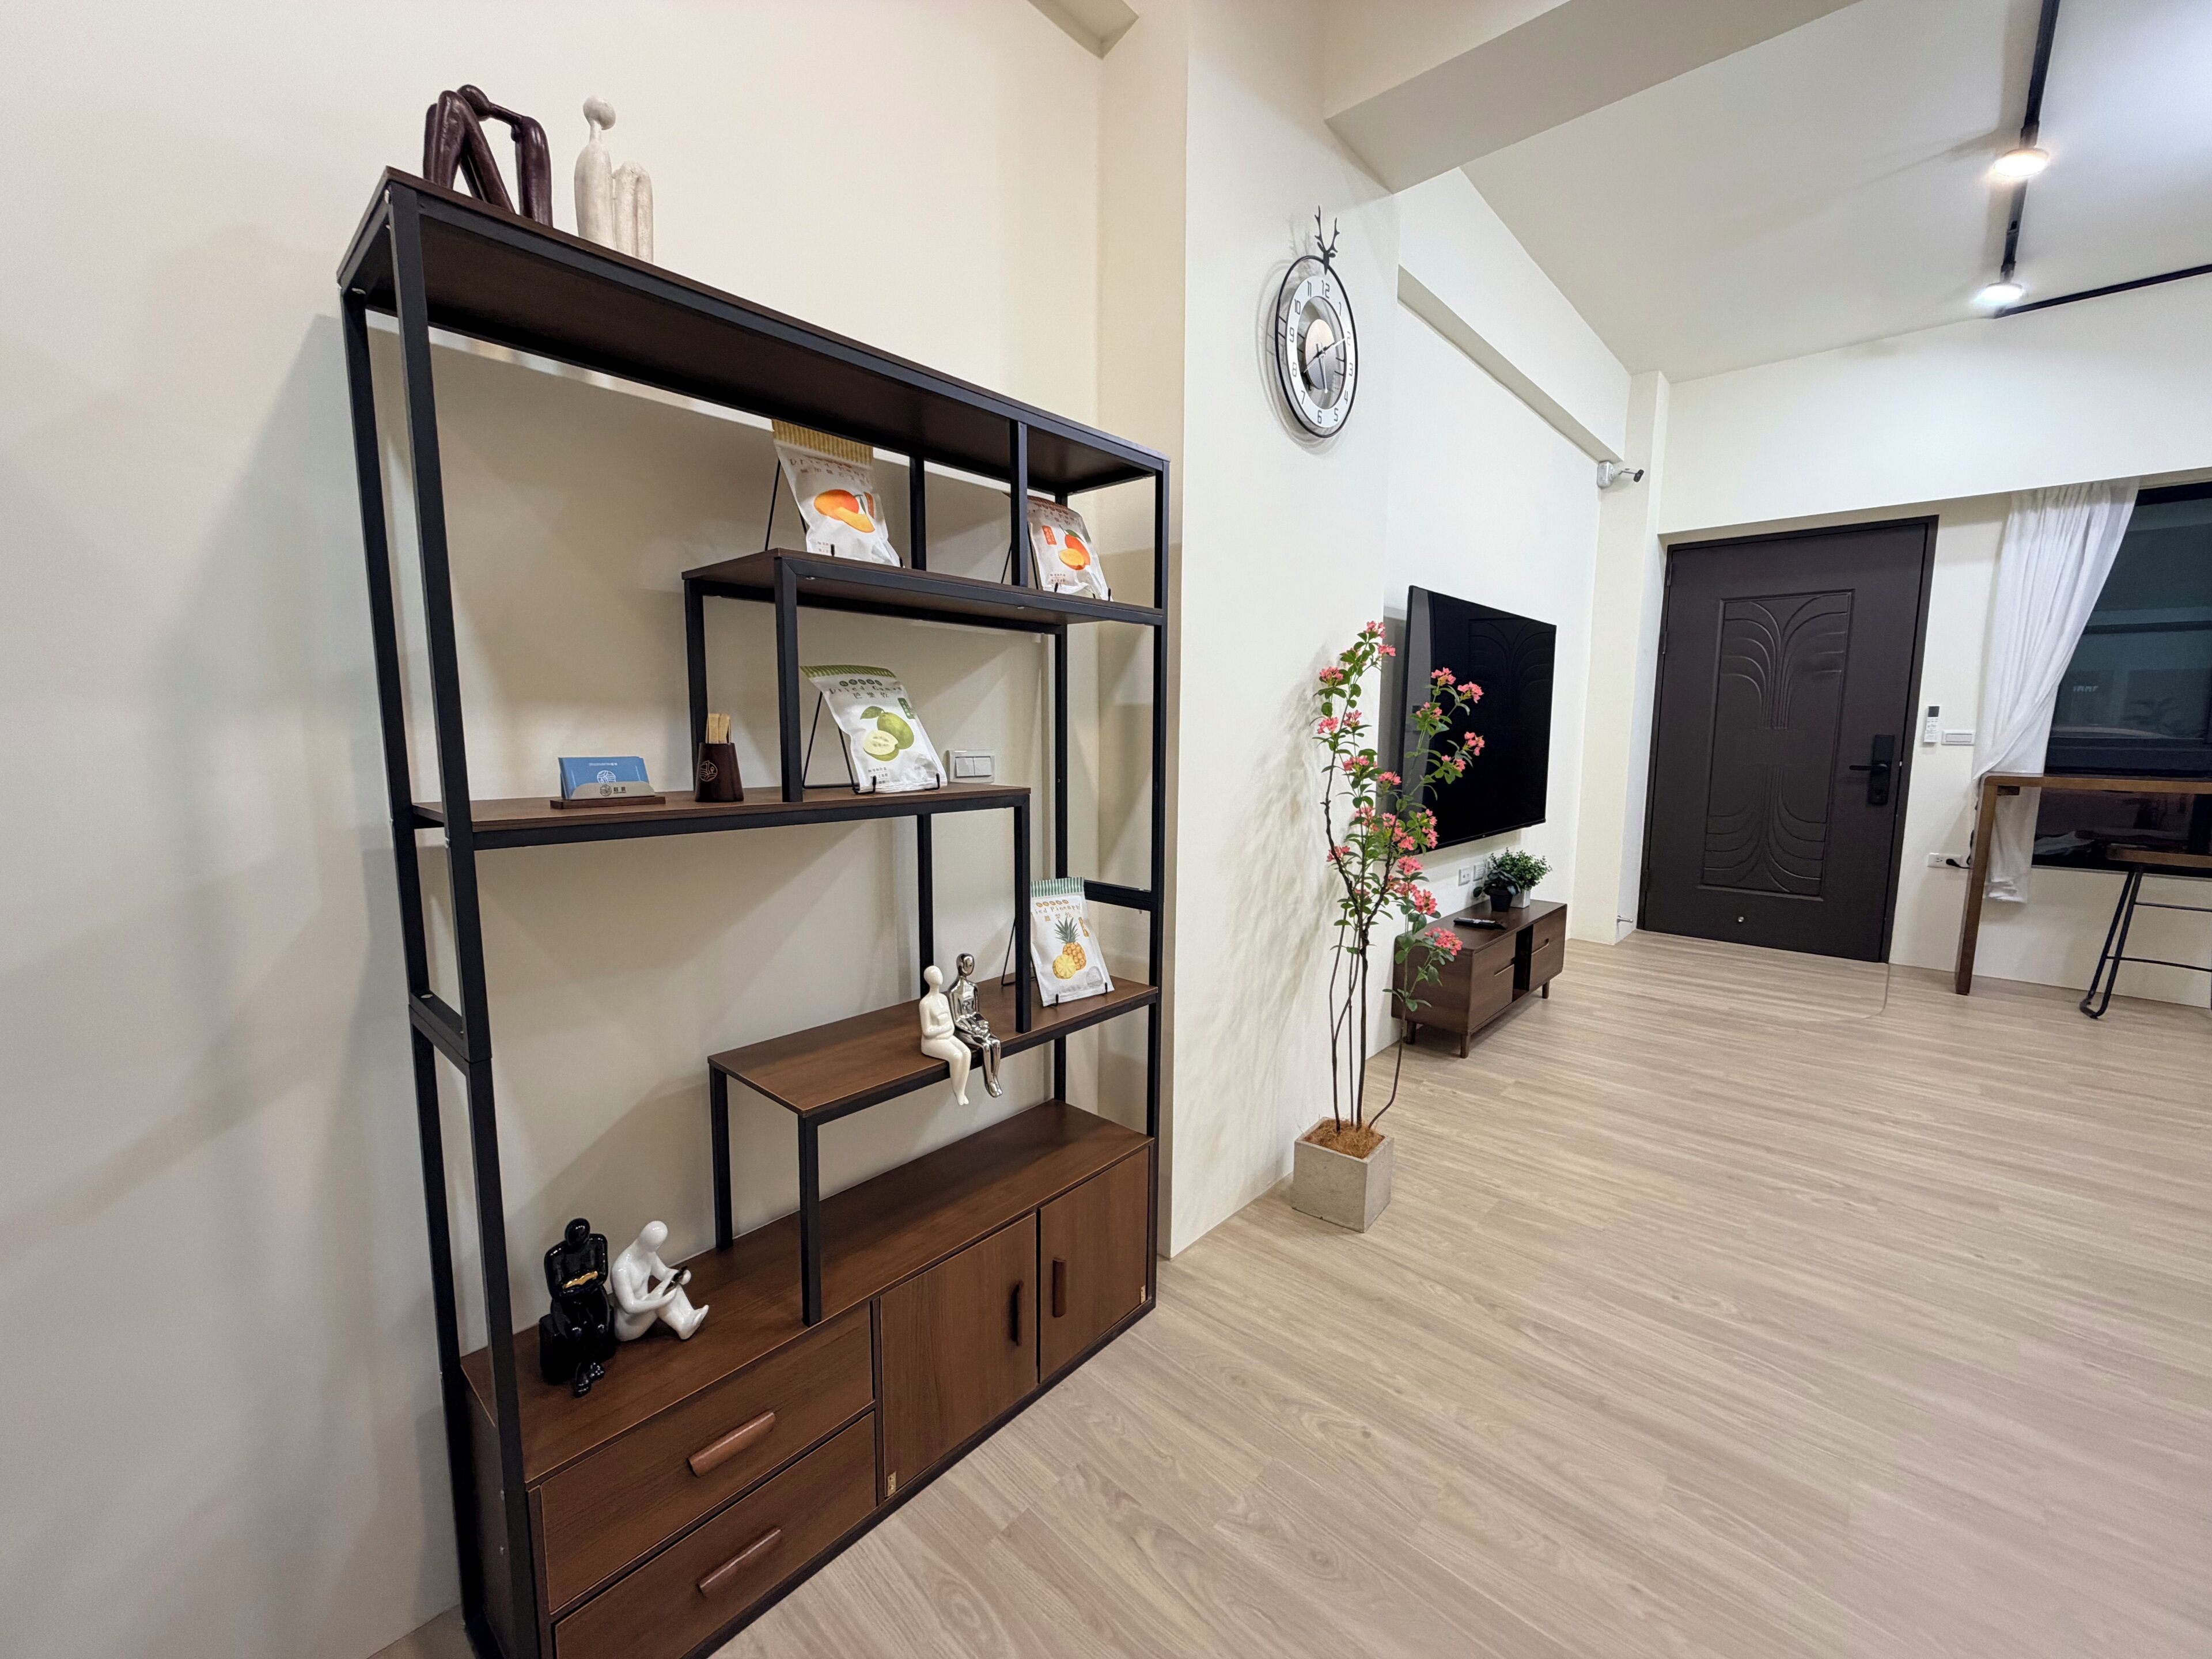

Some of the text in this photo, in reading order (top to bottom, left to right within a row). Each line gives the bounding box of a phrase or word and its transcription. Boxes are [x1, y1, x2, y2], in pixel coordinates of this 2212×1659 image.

[1307, 281, 1312, 298] 11
[1321, 279, 1330, 299] 12
[1294, 298, 1301, 315] 10
[1289, 327, 1294, 343] 9
[1346, 331, 1351, 346] 2
[1292, 362, 1297, 377] 8
[1349, 362, 1353, 377] 3
[1301, 390, 1305, 405] 7
[1344, 390, 1349, 404] 4
[1317, 410, 1323, 424] 6
[1334, 407, 1339, 422] 5
[1050, 903, 1081, 912] Pineappl
